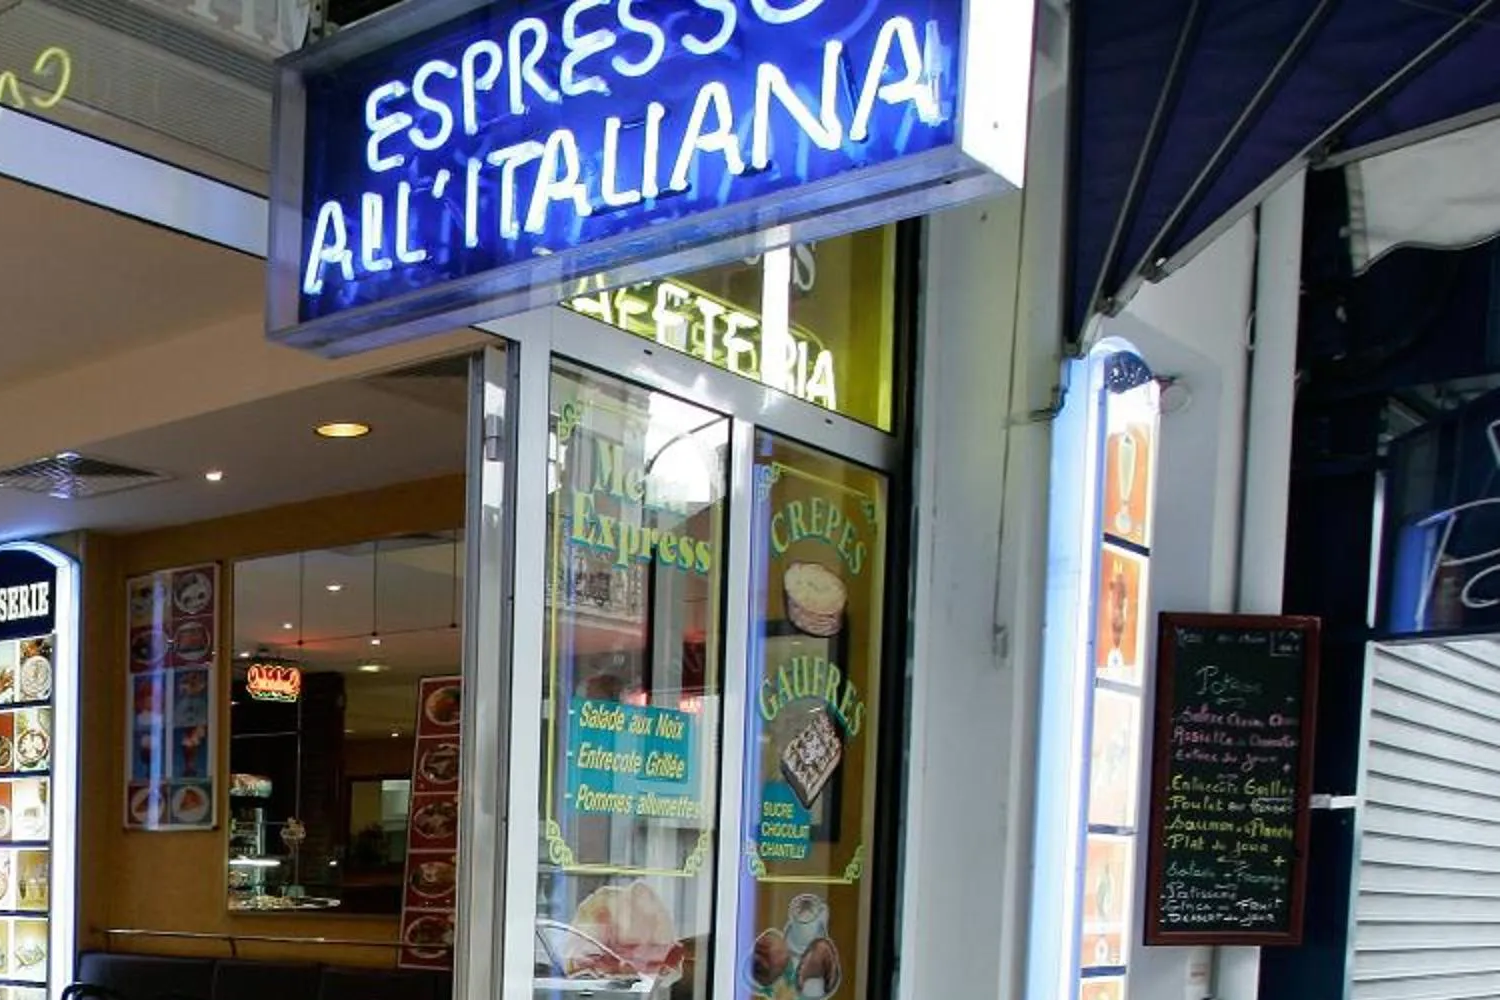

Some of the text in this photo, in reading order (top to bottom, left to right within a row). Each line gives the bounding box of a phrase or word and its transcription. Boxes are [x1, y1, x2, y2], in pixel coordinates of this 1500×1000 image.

[365, 0, 830, 173] ESPRESS
[303, 16, 946, 295] ALL'ITALIANA
[569, 491, 712, 575] Express
[770, 496, 867, 576] CREPES
[579, 700, 626, 733] Salade
[656, 712, 685, 741] Noix
[758, 655, 866, 737] GAUFRES
[575, 783, 634, 815] Pommes
[761, 821, 810, 841] CHOCOLAT
[763, 801, 795, 818] SUCRE
